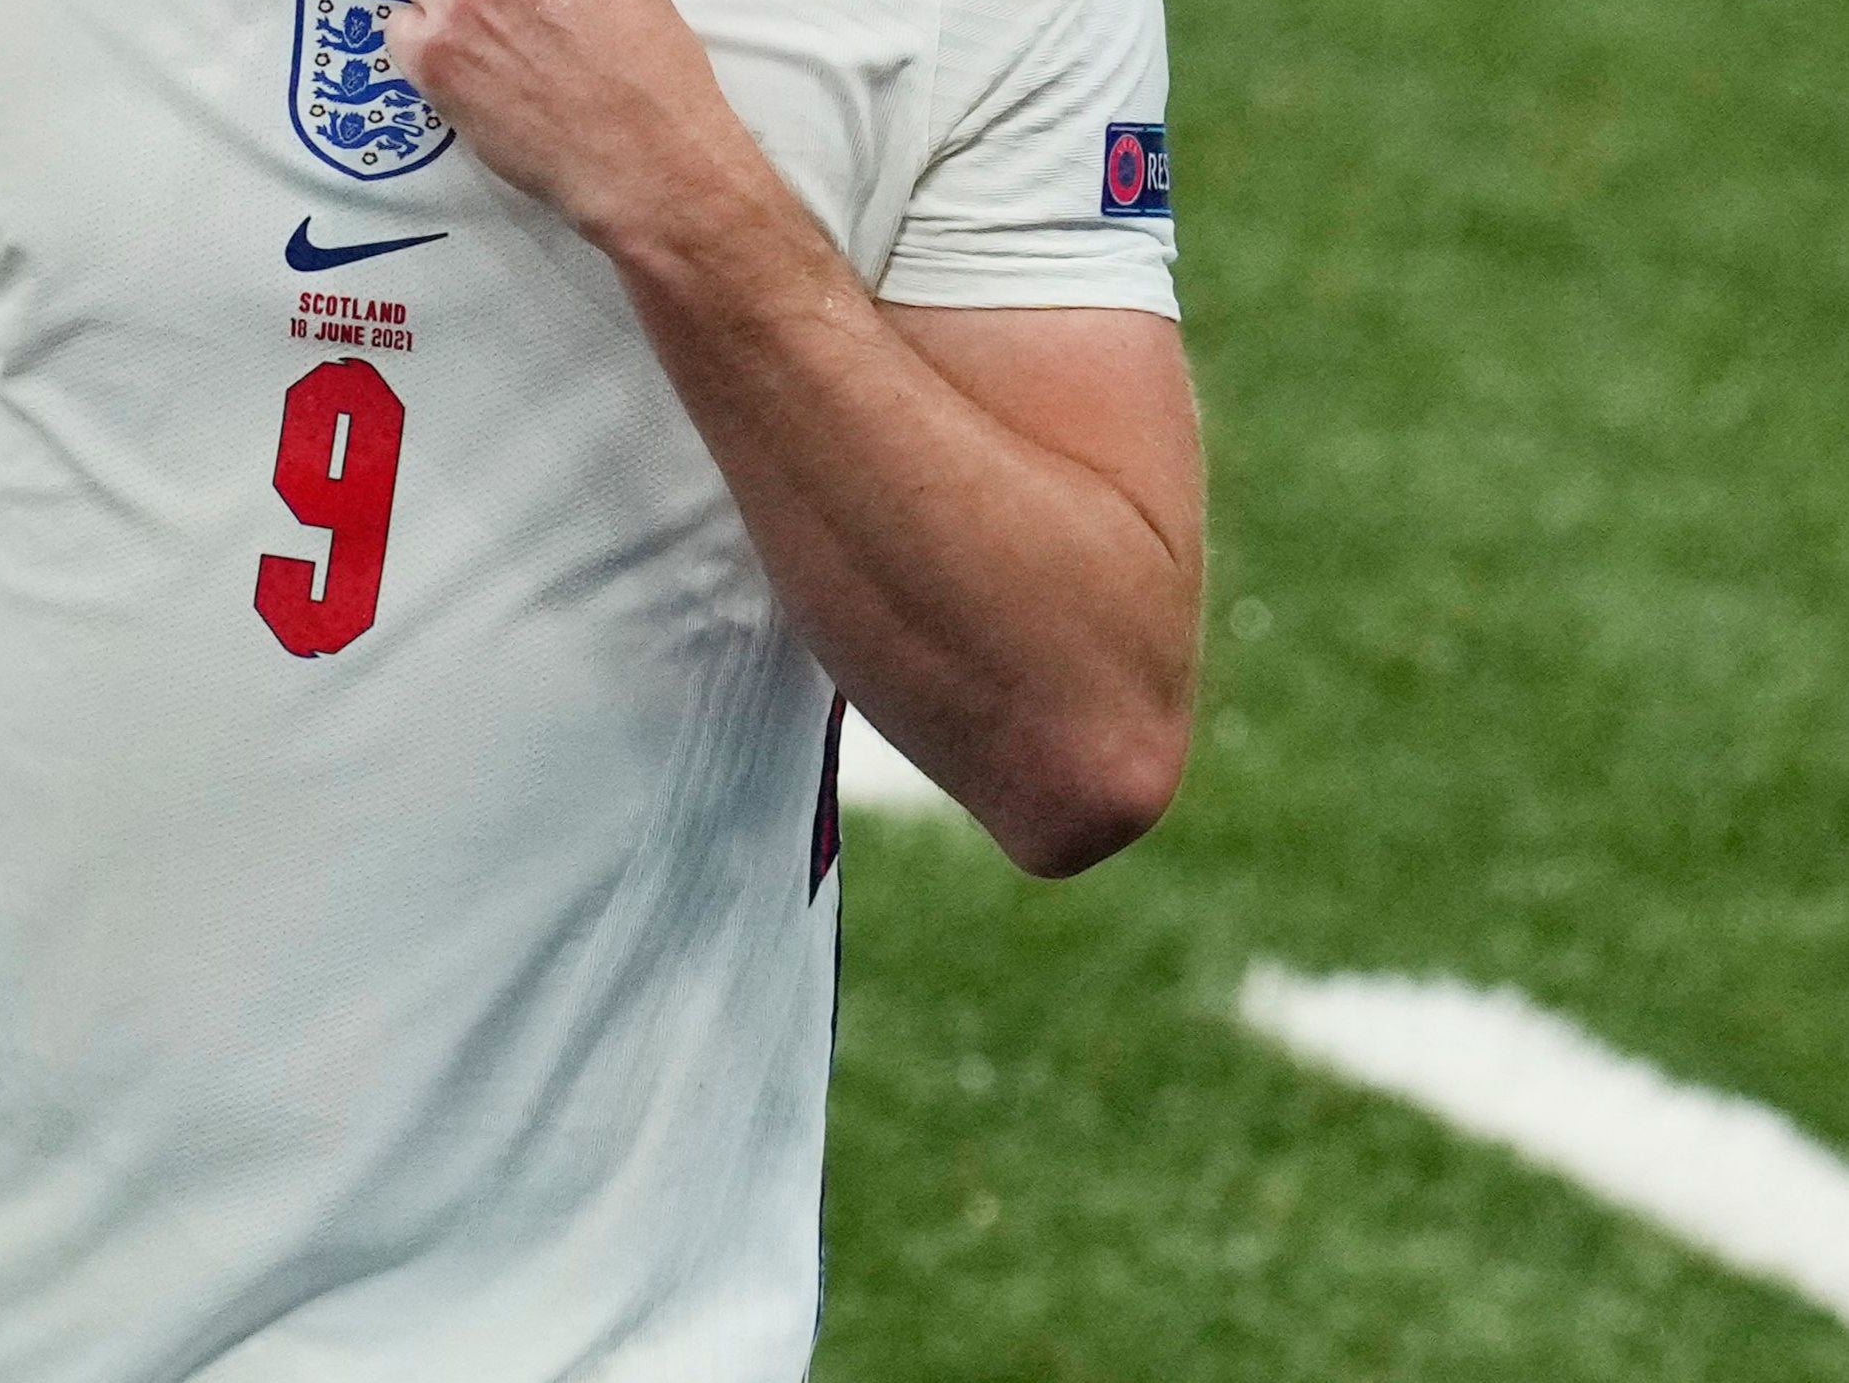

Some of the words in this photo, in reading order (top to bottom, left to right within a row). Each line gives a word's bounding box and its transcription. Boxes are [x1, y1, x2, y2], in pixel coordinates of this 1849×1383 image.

[299, 292, 406, 324] SCOTLAND
[291, 318, 308, 338] 18
[315, 323, 365, 346] JUNE
[371, 328, 413, 351] 2021
[254, 357, 405, 658] 9
